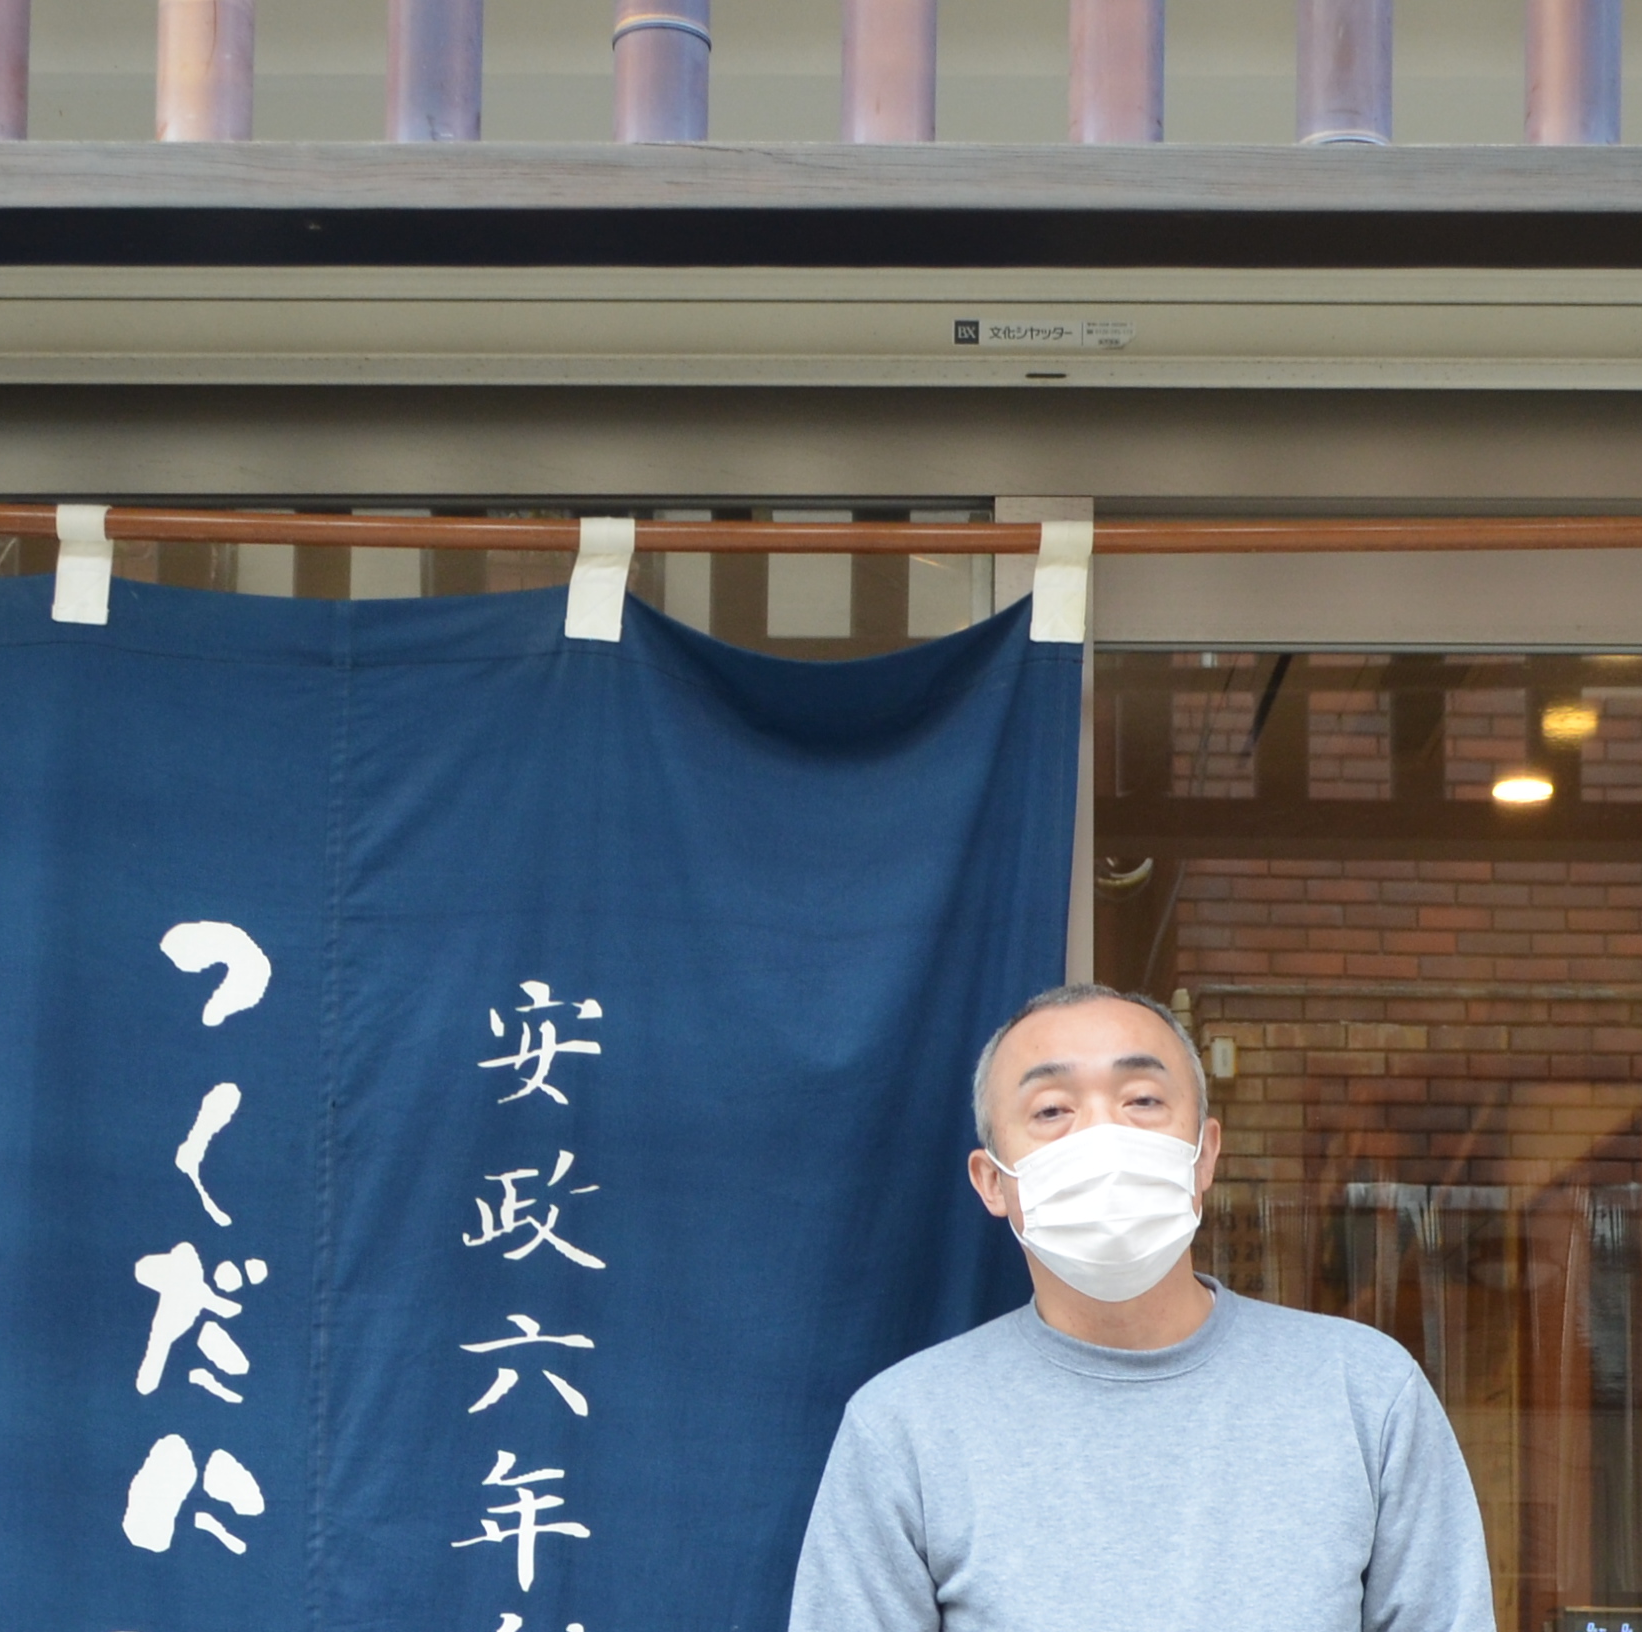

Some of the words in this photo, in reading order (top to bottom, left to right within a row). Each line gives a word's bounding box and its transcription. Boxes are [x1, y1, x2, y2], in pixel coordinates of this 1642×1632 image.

[958, 325, 977, 339] BX
[122, 920, 271, 1555] つくだに
